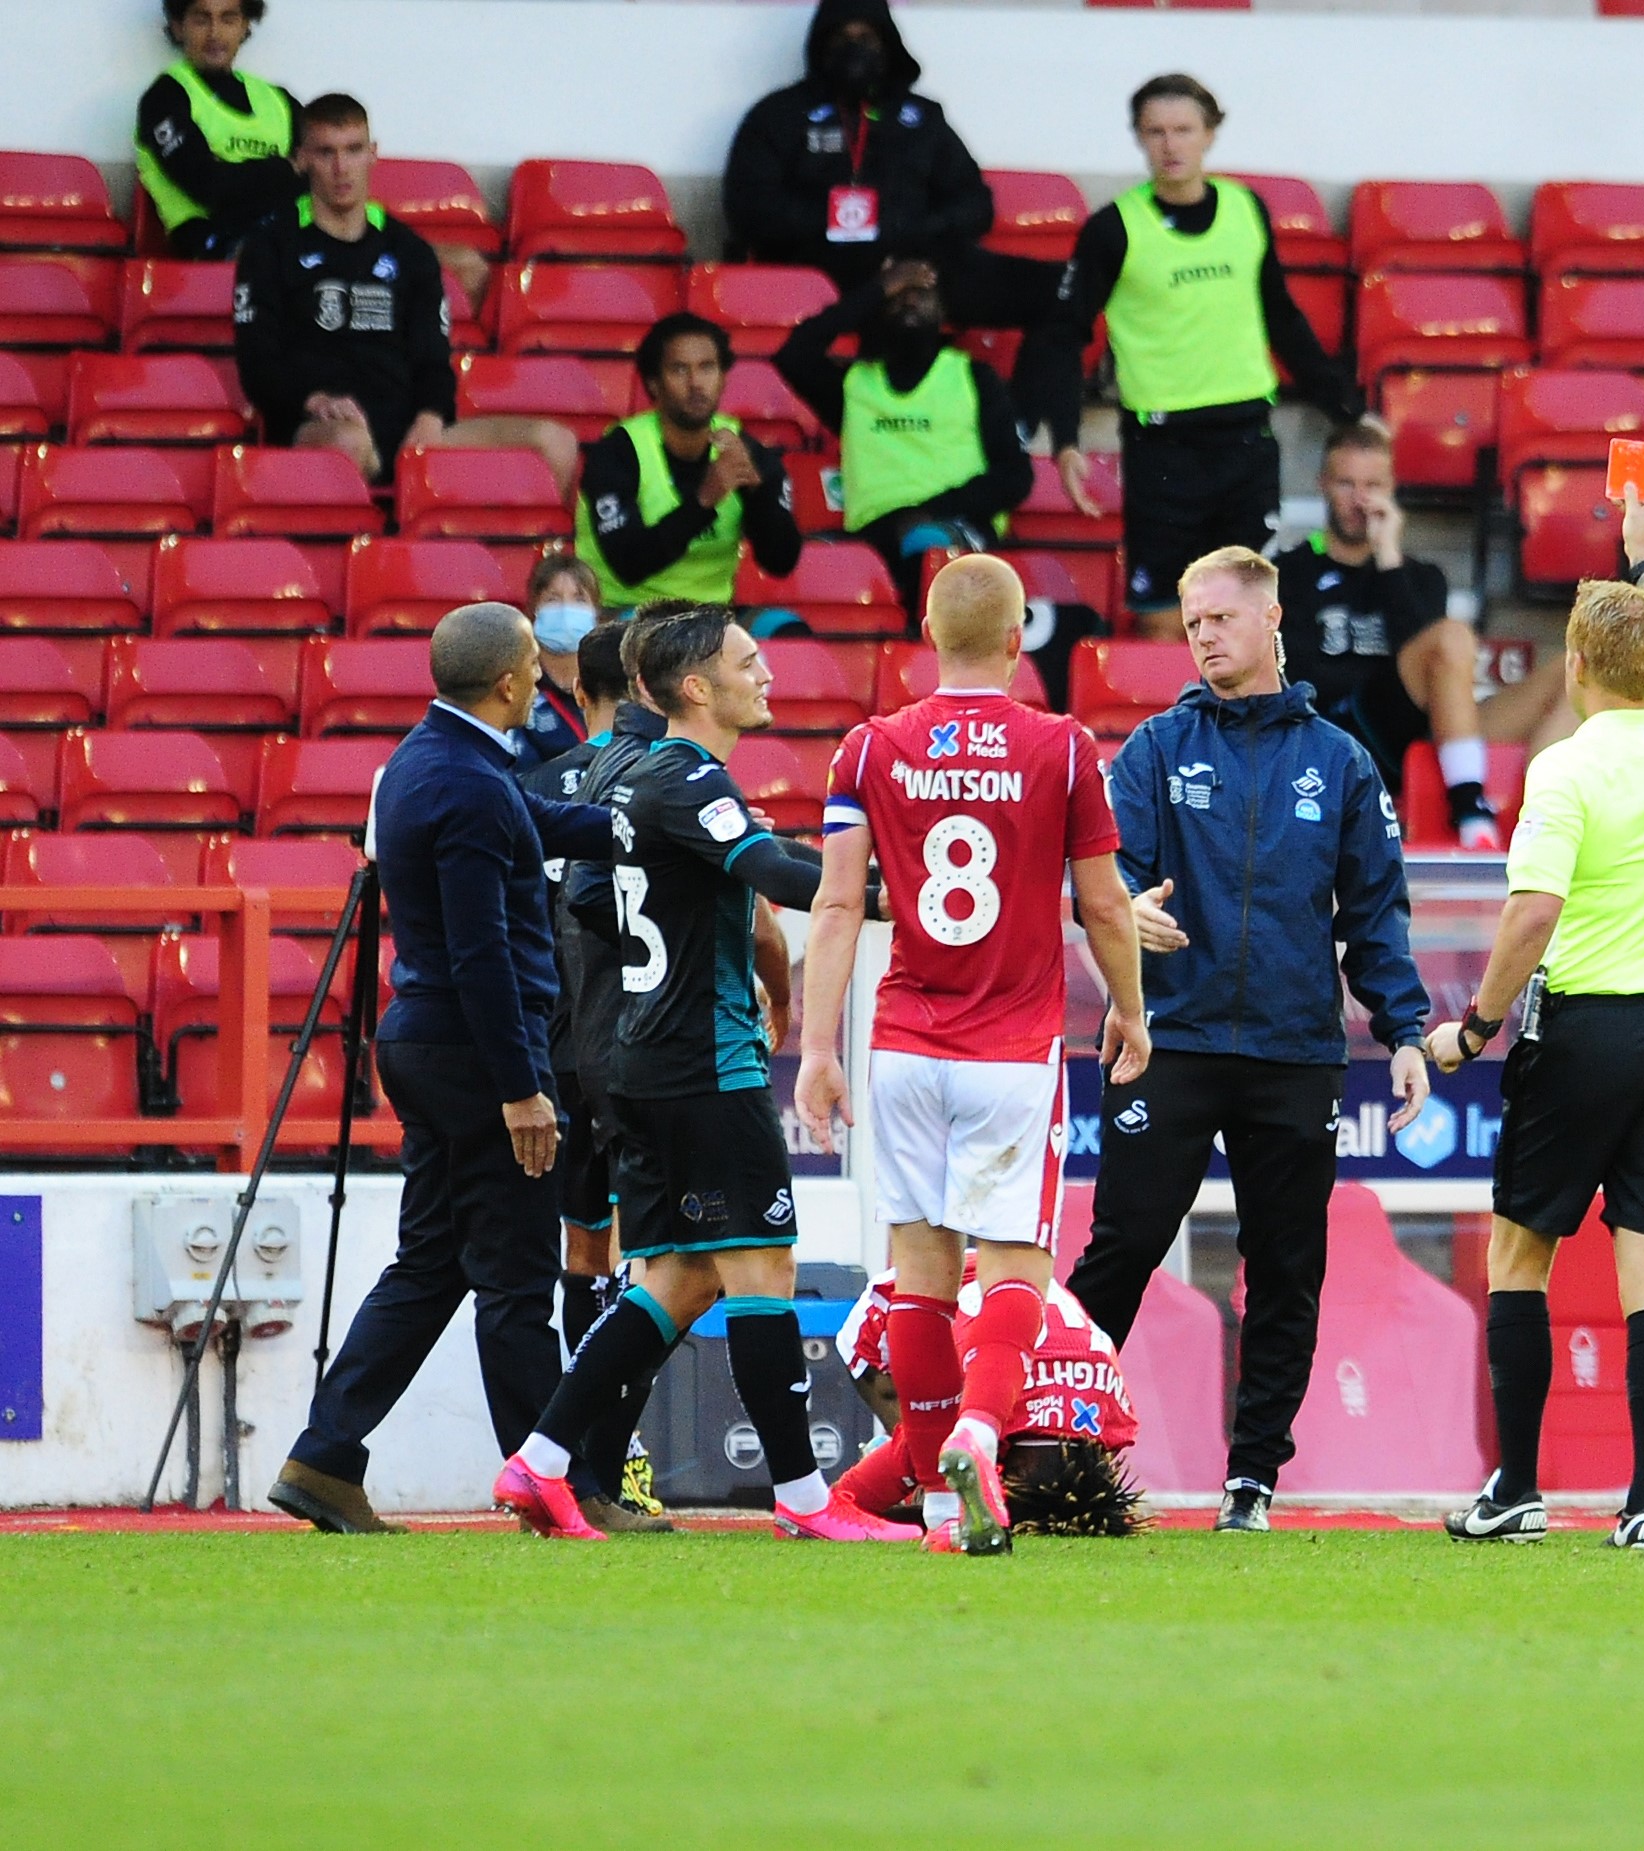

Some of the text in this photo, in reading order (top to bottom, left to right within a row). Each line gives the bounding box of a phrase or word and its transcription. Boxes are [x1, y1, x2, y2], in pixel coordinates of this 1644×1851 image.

[967, 721, 1007, 745] UK
[967, 742, 1008, 758] Meds
[904, 768, 1023, 802] WATSON
[917, 814, 1001, 946] 8
[612, 864, 667, 992] 3
[1026, 1395, 1064, 1413] Meds
[1025, 1406, 1064, 1428] UK
